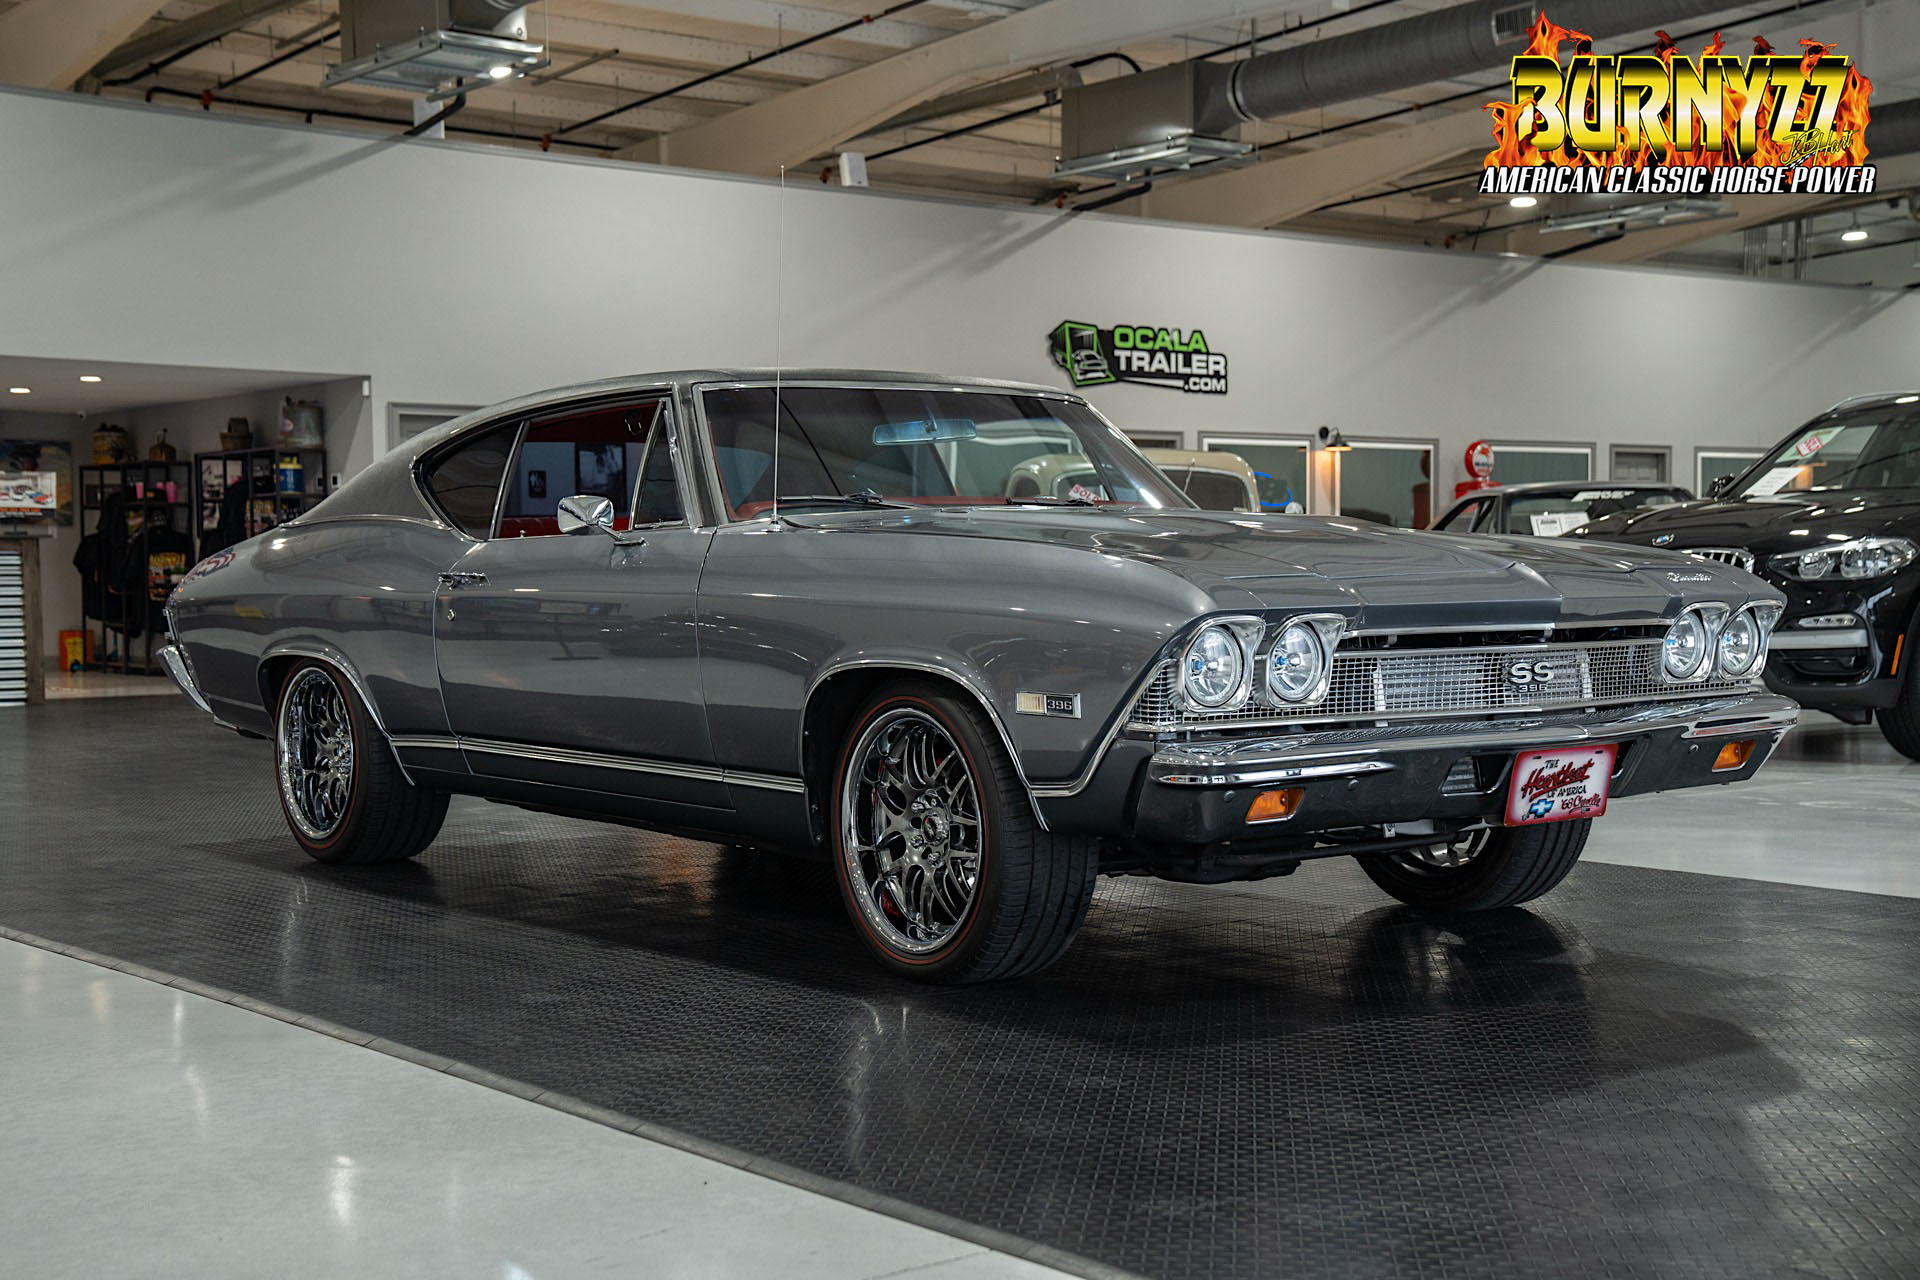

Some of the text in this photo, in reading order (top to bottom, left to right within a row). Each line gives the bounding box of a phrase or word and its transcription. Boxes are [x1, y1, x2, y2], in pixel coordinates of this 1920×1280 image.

[1114, 326, 1208, 352] OCALA
[1114, 350, 1226, 376] TRAILER
[1184, 378, 1226, 392] .COM
[1511, 661, 1554, 684] SS
[1047, 700, 1072, 710] 396
